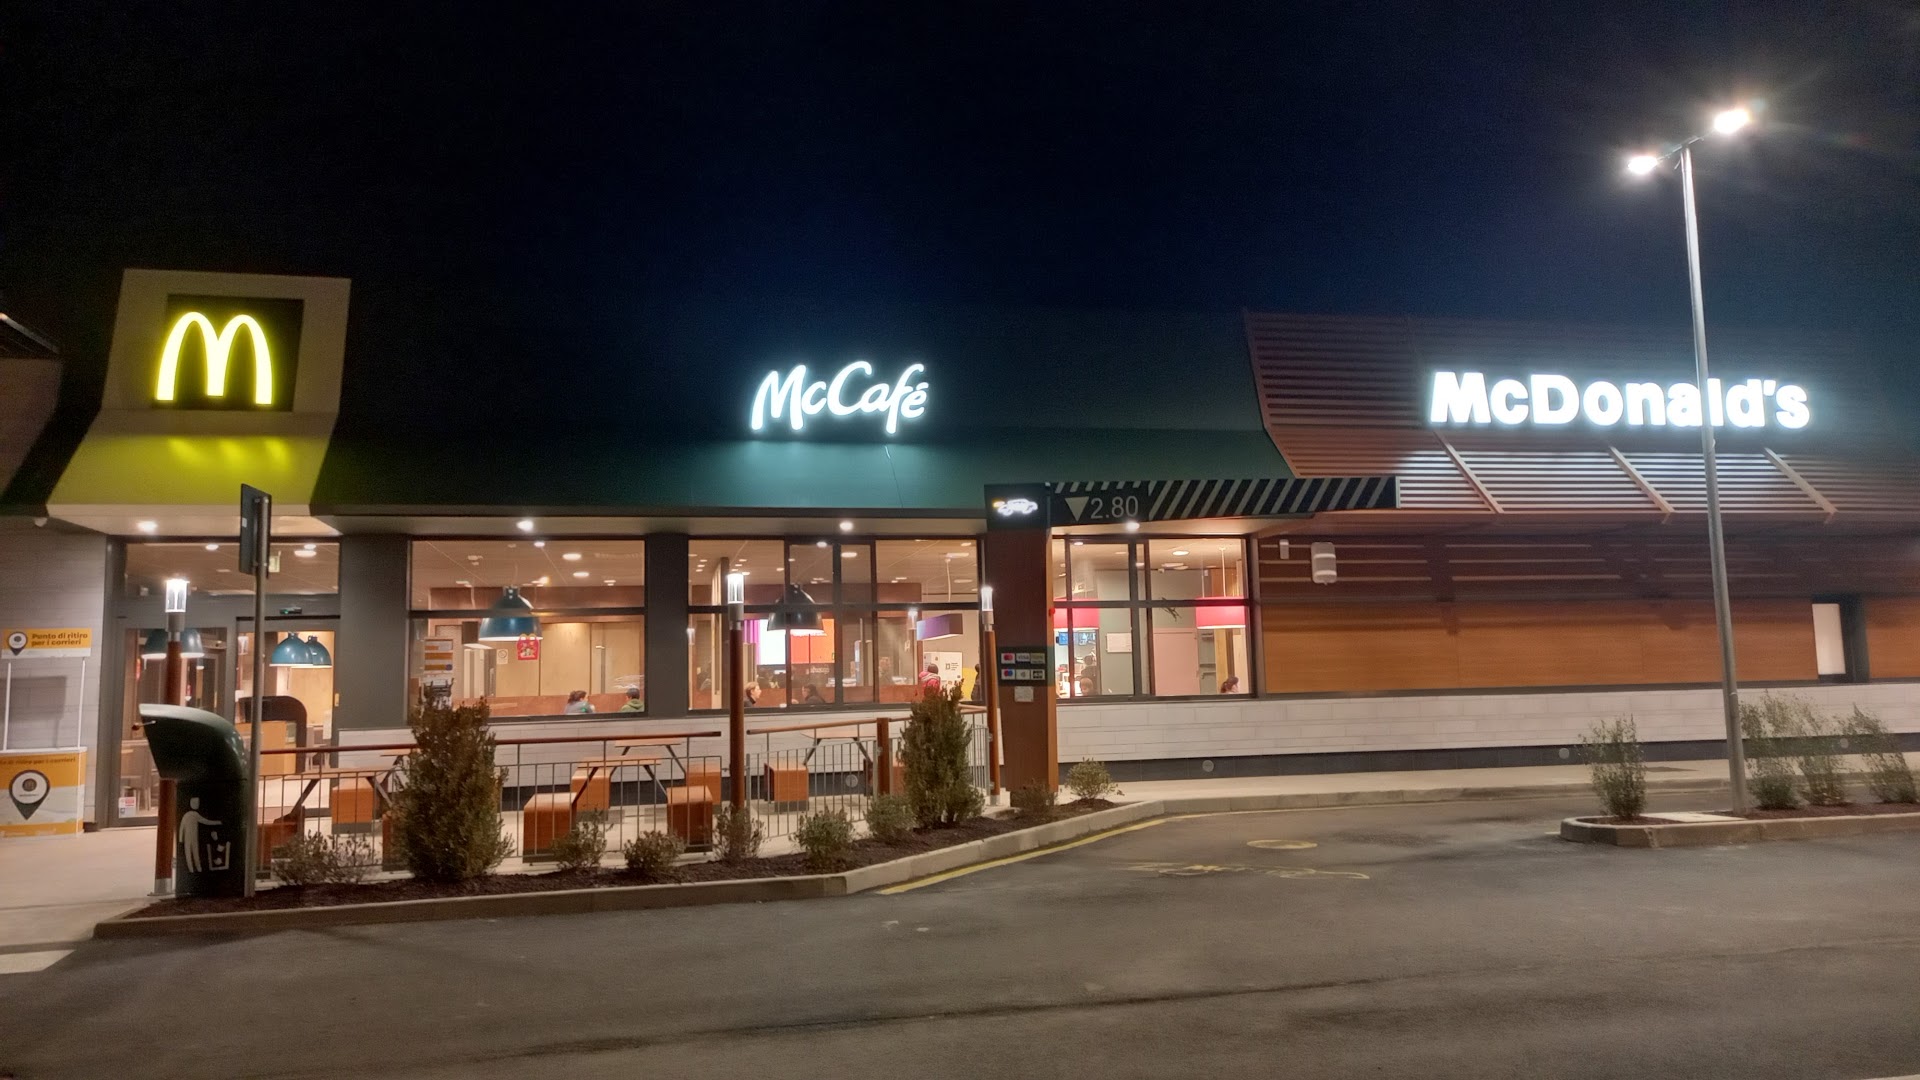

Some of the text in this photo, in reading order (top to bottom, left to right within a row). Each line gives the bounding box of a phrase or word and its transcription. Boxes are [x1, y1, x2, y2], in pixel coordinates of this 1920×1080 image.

[751, 360, 929, 434] McCafé
[1430, 371, 1811, 429] McDonald's
[1090, 495, 1139, 519] 2.80
[67, 632, 88, 640] ritiro
